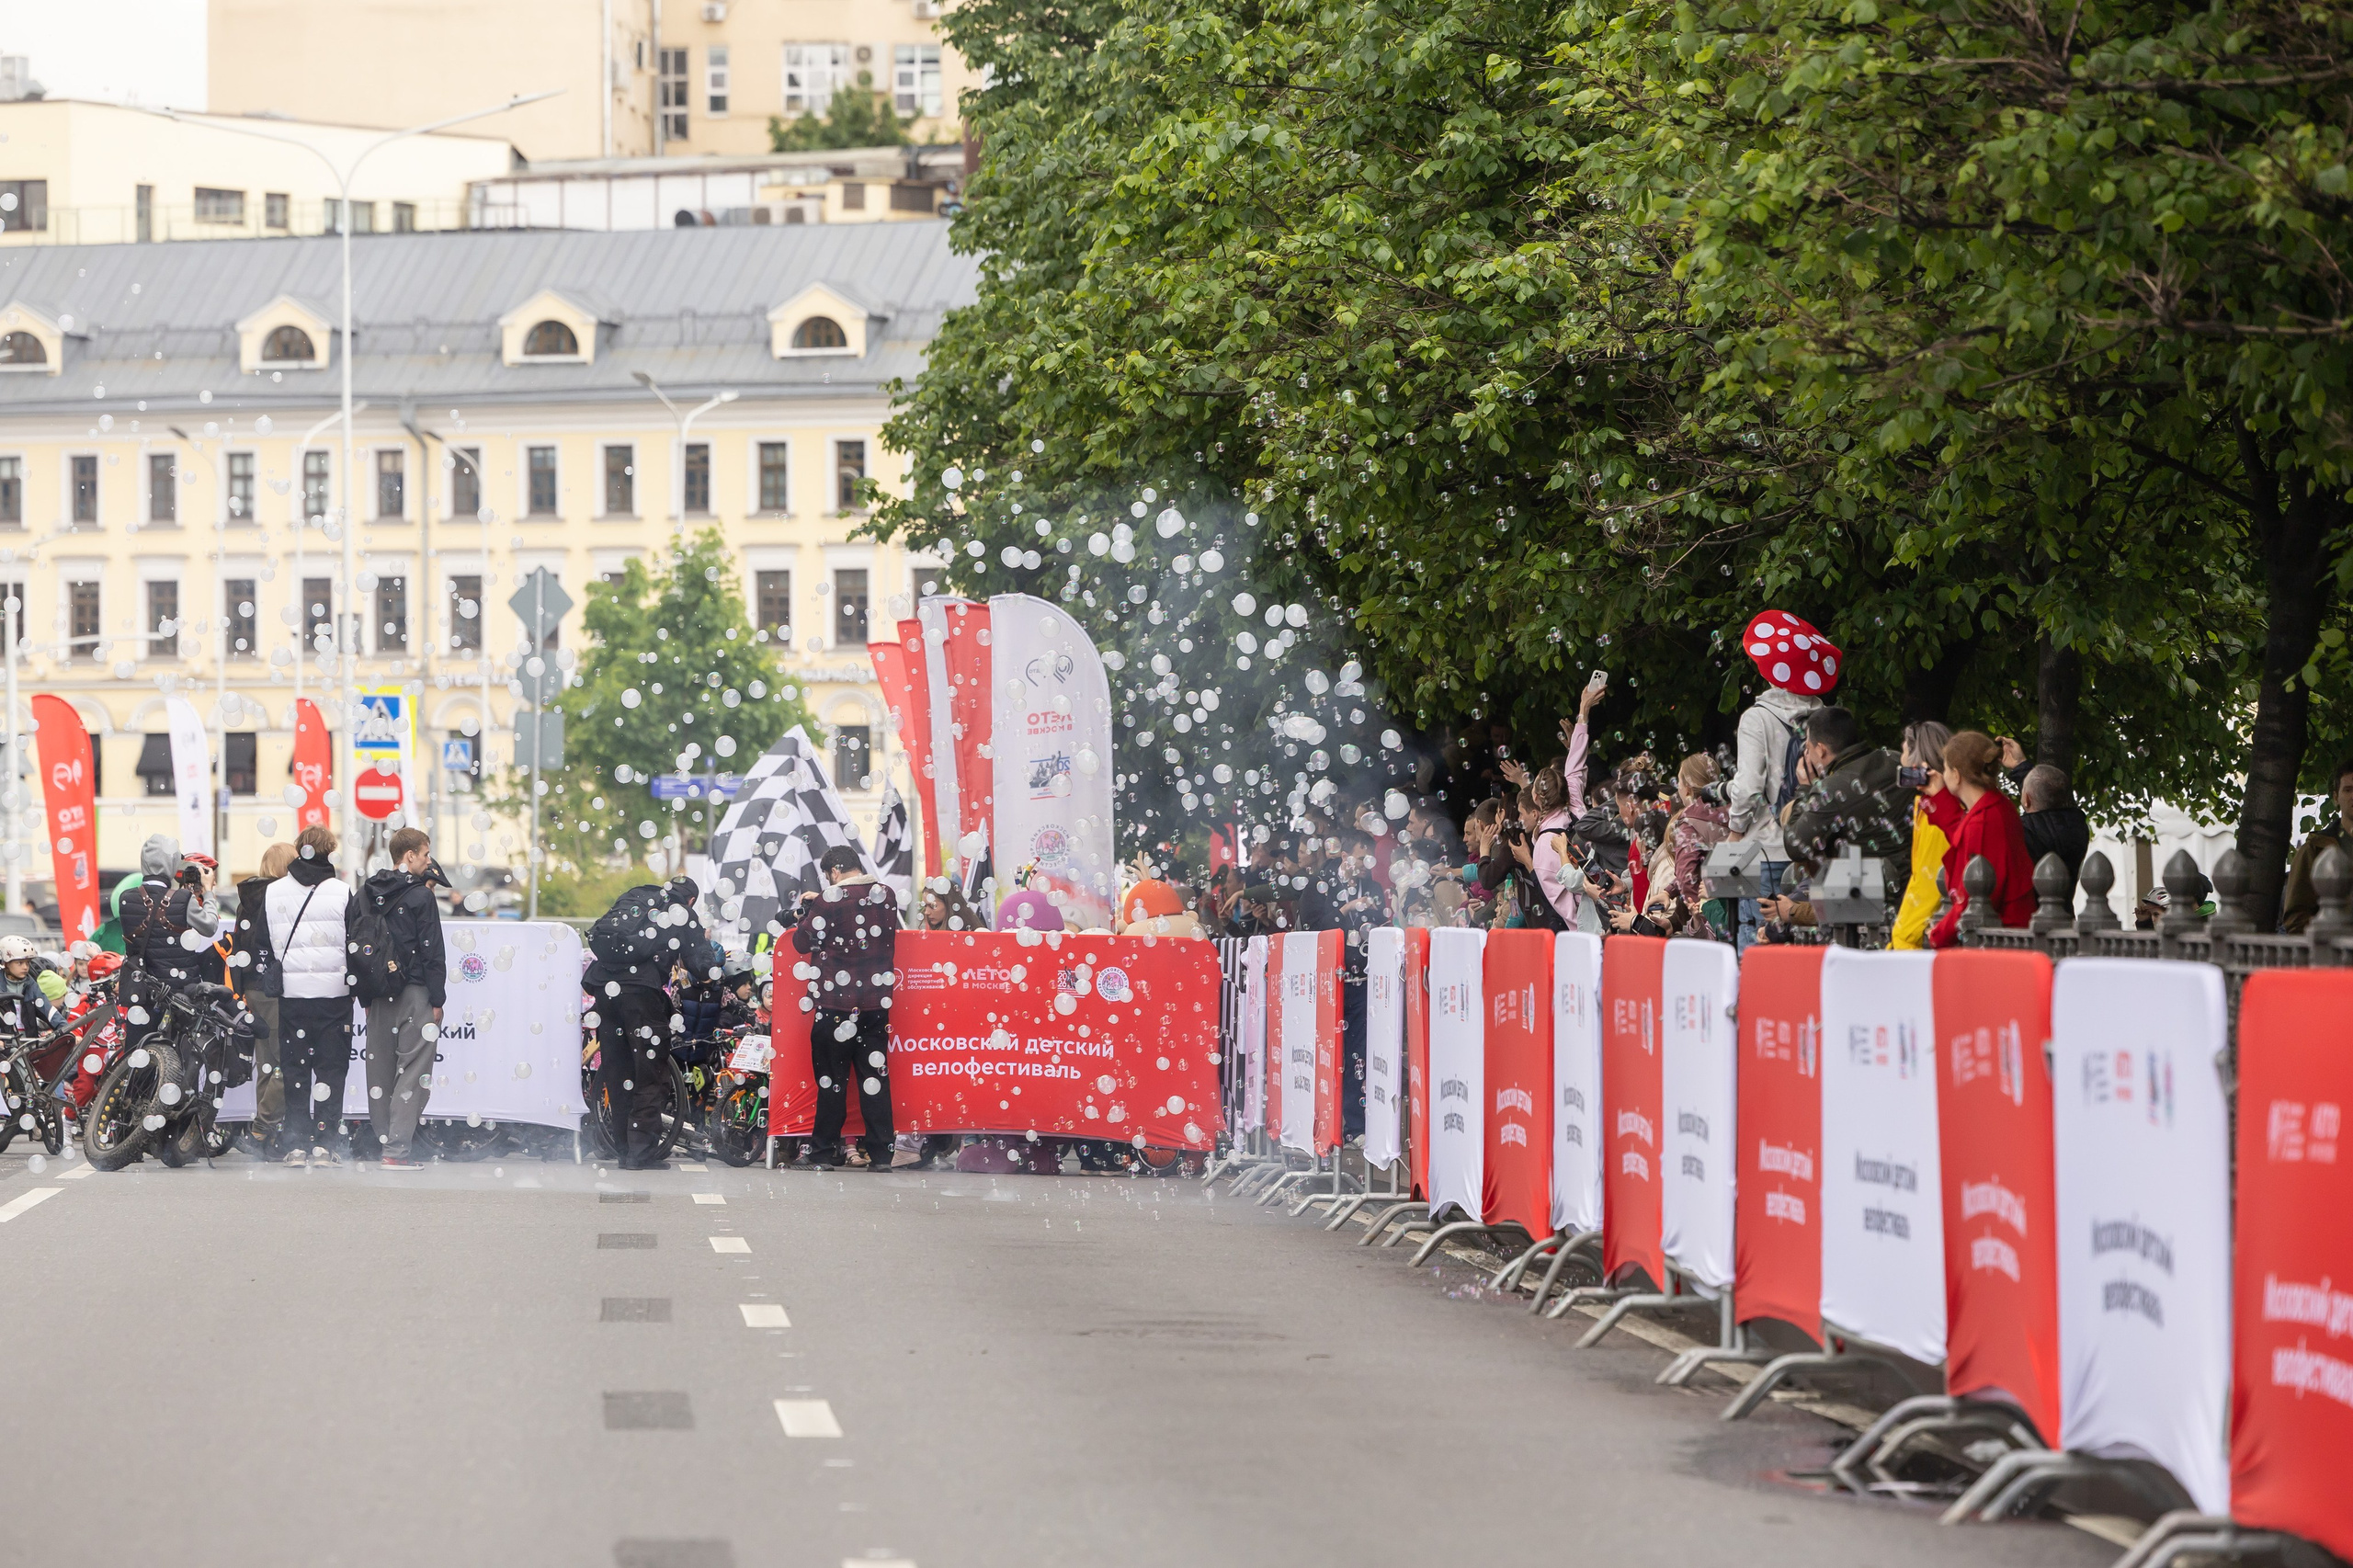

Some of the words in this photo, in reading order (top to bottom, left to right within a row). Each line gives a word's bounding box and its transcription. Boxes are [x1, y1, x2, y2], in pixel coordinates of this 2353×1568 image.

[964, 968, 1011, 981] ЛЕТО
[1057, 980, 1067, 988] 26
[888, 1032, 1019, 1053] Московскй
[1025, 1039, 1114, 1058] детский
[912, 1056, 1082, 1080] велофестиваль
